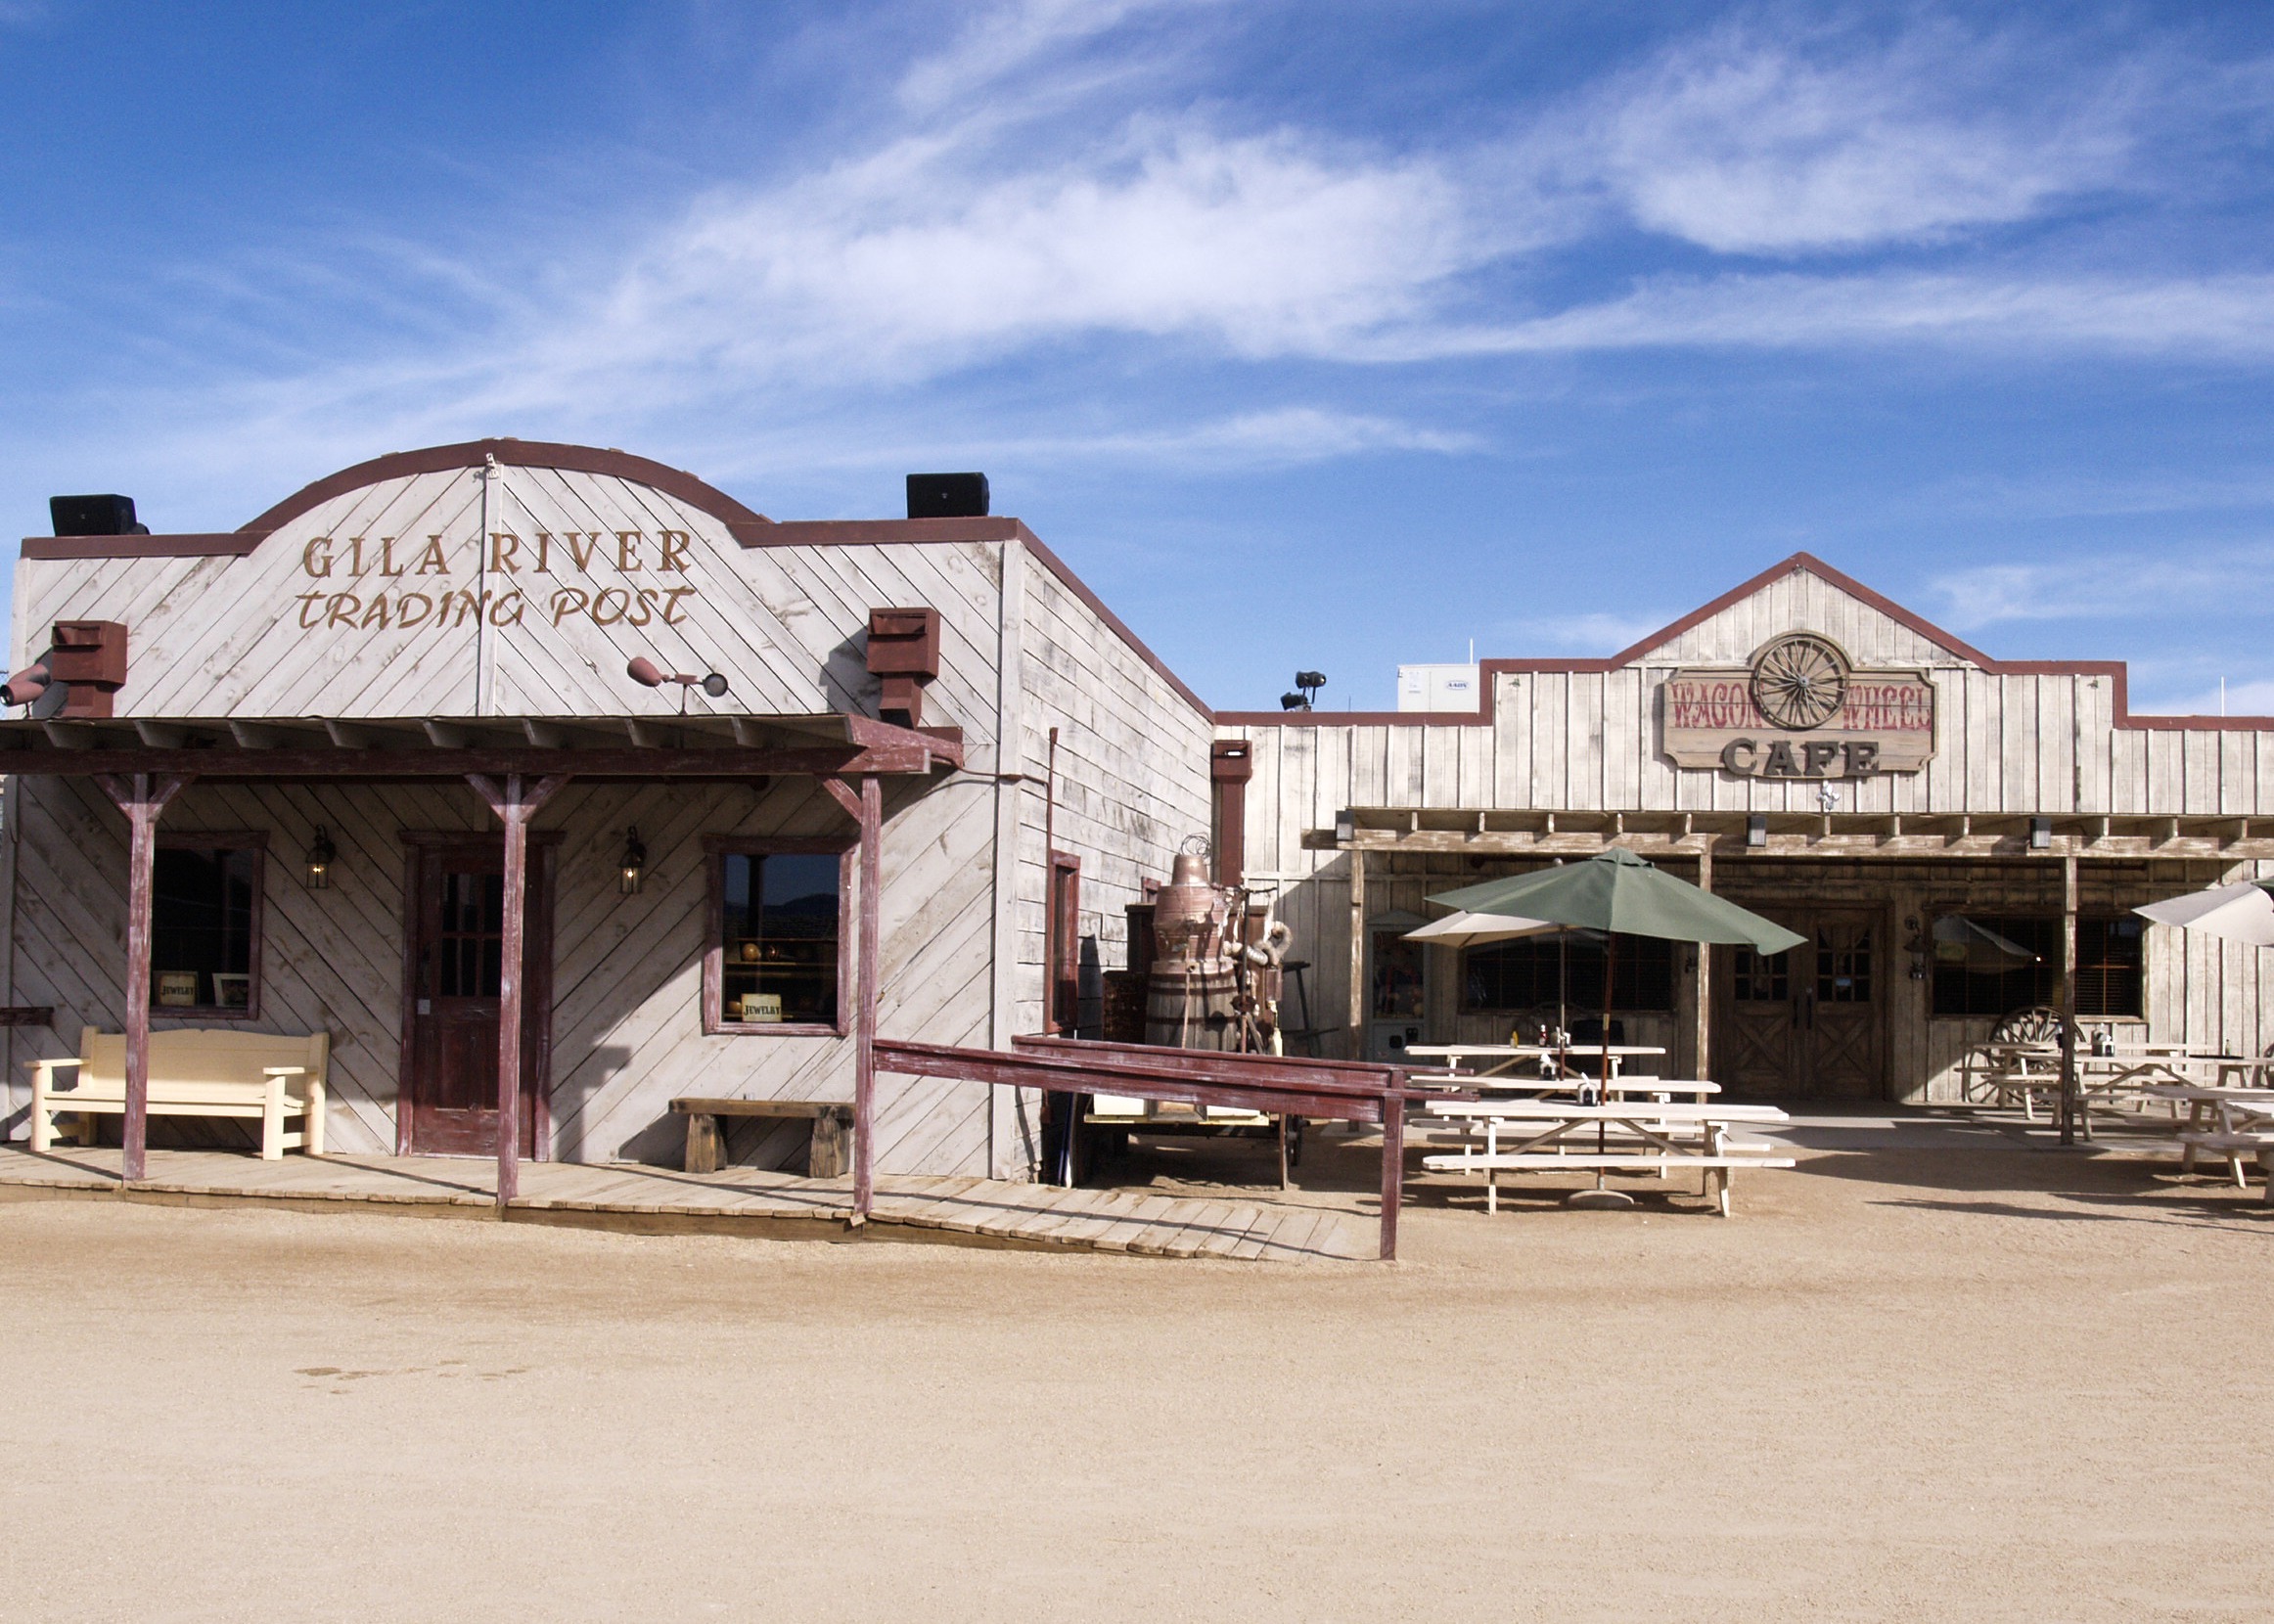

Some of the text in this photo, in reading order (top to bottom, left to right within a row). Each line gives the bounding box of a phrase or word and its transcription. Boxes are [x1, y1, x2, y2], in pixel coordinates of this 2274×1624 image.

[303, 529, 691, 578] GILA RIVER
[296, 587, 696, 631] TRADING POST
[1671, 682, 1932, 731] WAGON WHEEL
[1722, 737, 1880, 777] CAFE
[744, 1005, 780, 1015] JEWELRY
